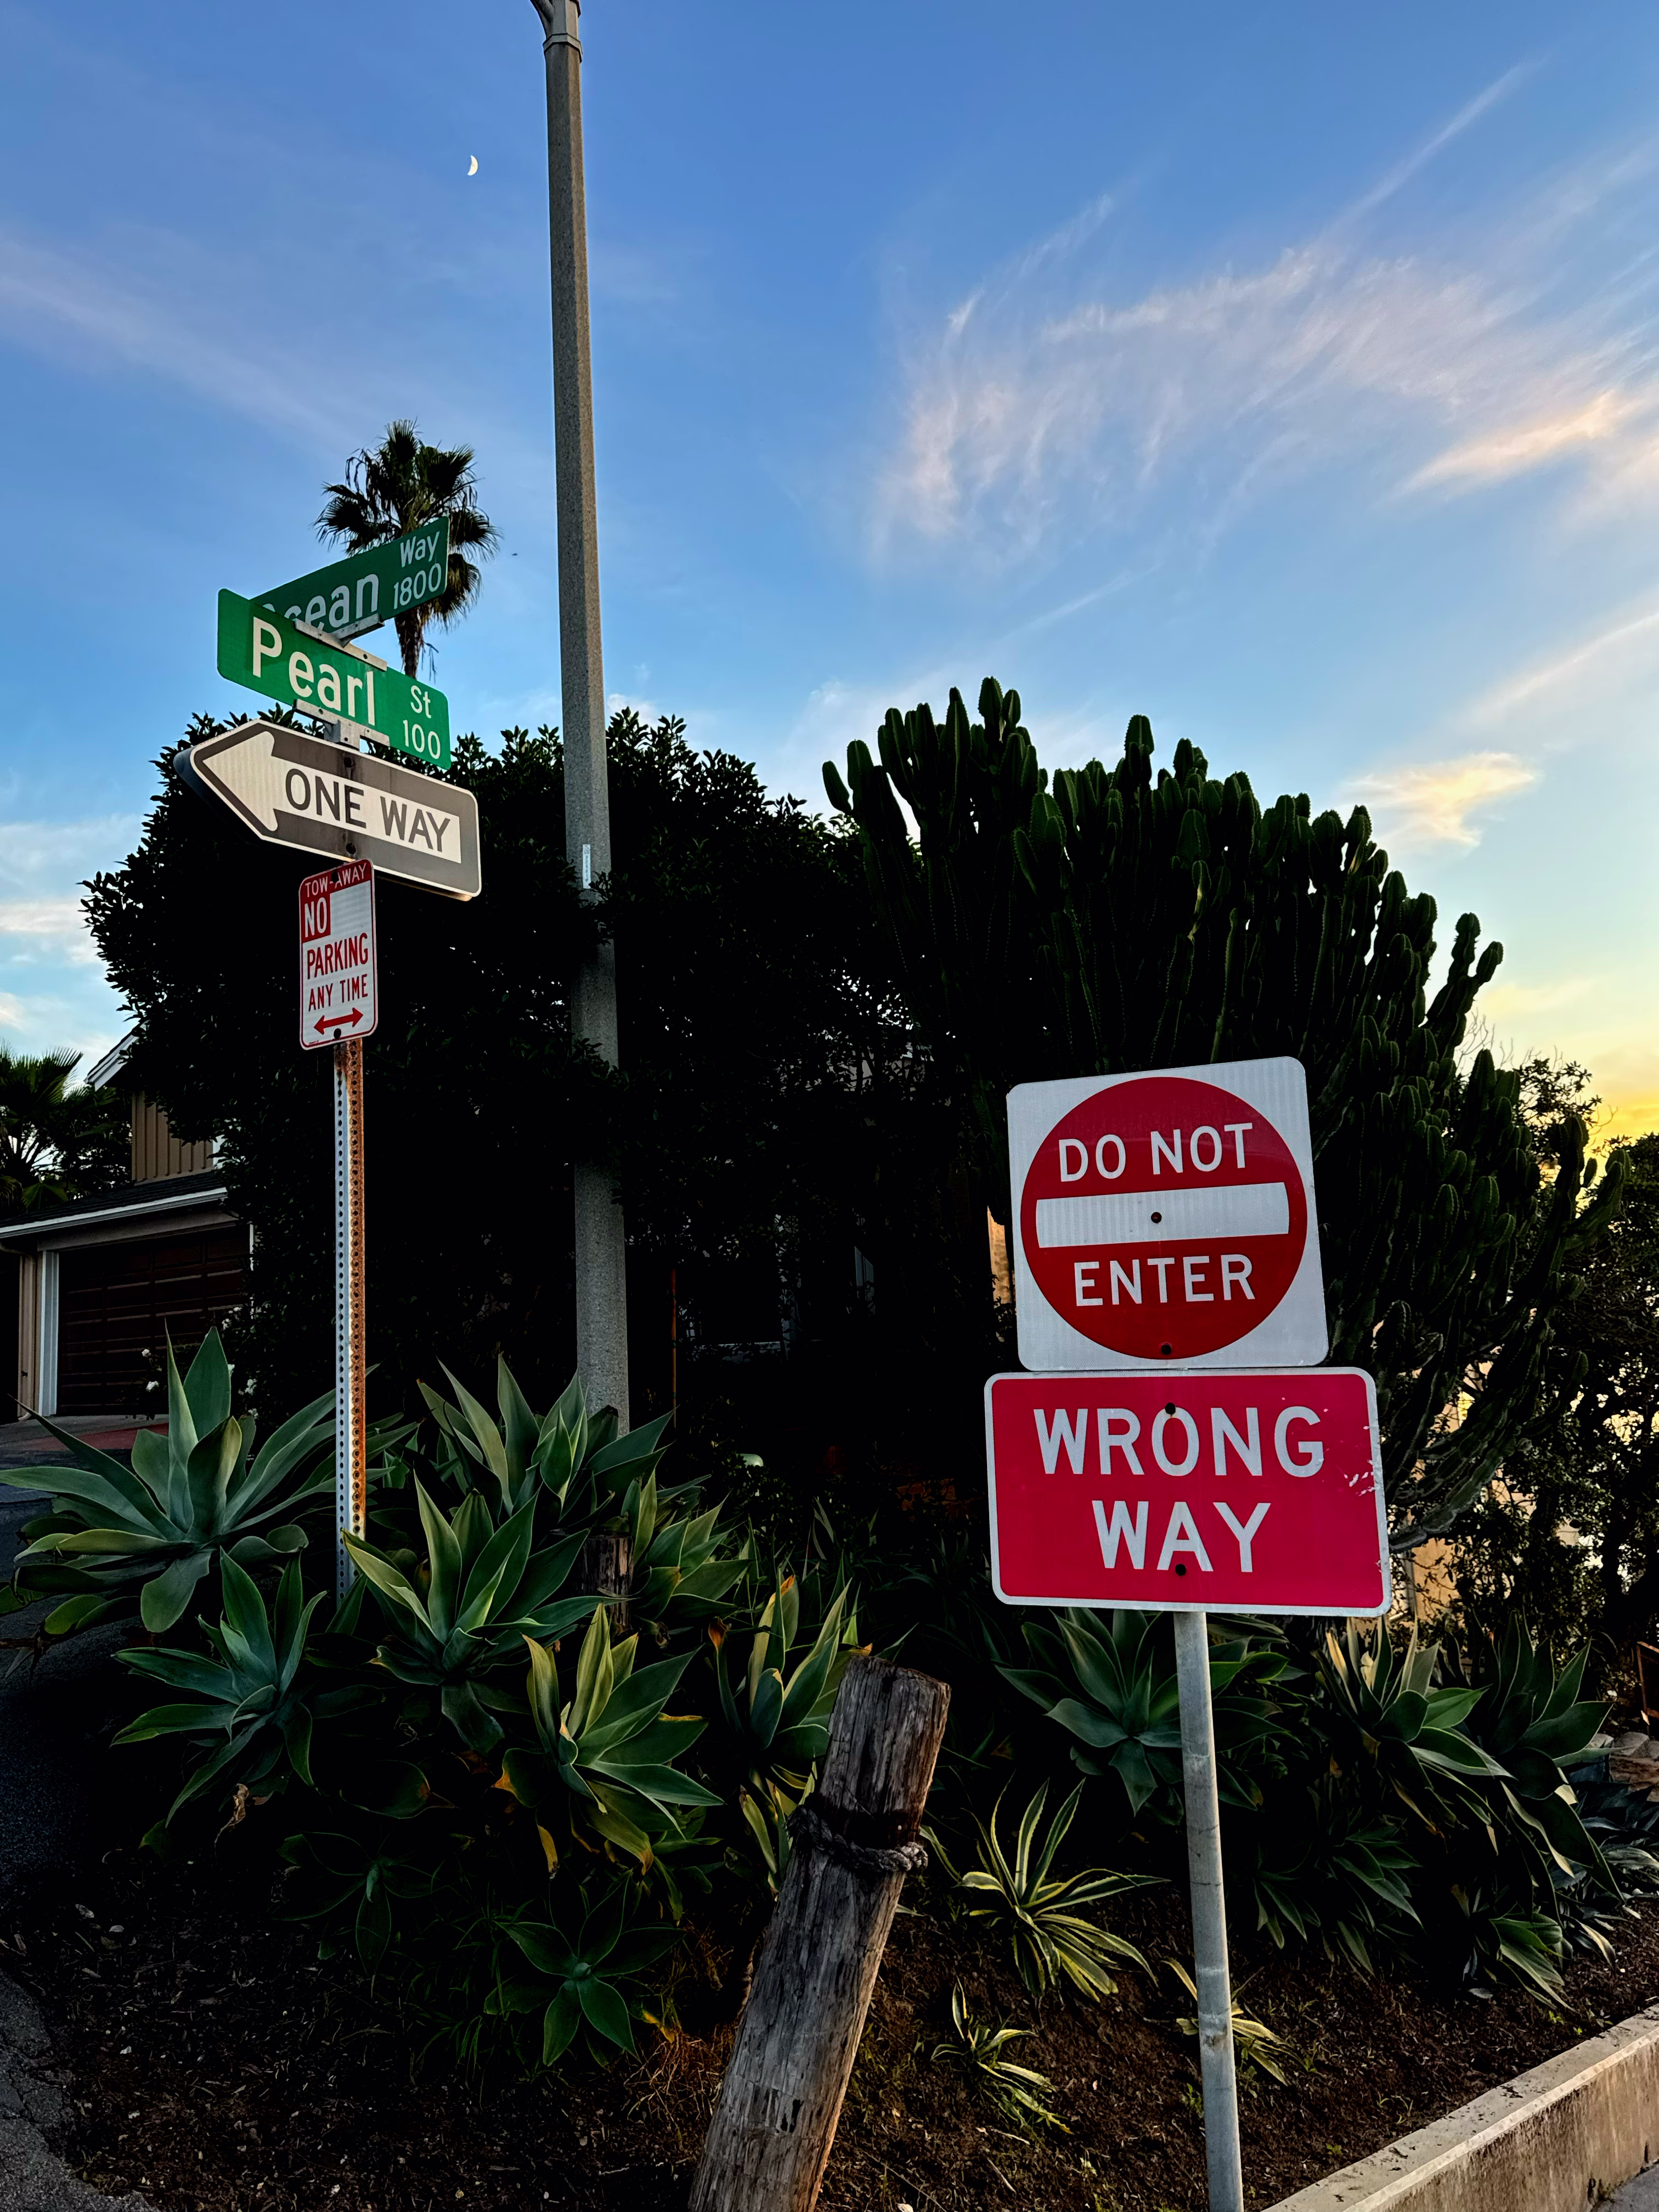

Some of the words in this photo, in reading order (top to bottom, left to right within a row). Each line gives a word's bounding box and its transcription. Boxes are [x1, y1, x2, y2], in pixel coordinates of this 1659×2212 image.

[400, 531, 440, 568] Way
[393, 563, 442, 610] 1800
[252, 616, 376, 726] Pearl
[410, 685, 432, 719] St
[403, 719, 441, 760] 100
[285, 768, 367, 829] ONE
[380, 795, 451, 853] WAY
[304, 862, 368, 898] TOW-AWAY
[304, 897, 328, 938] NO
[307, 932, 369, 980] PARKING
[308, 983, 334, 1012] ANY
[340, 973, 368, 1003] TIME
[1058, 1134, 1126, 1182] DO
[1150, 1122, 1253, 1175] NOT
[1074, 1254, 1256, 1307] ENTER
[1033, 1406, 1325, 1478] WRONG
[1091, 1500, 1272, 1573] WAY
